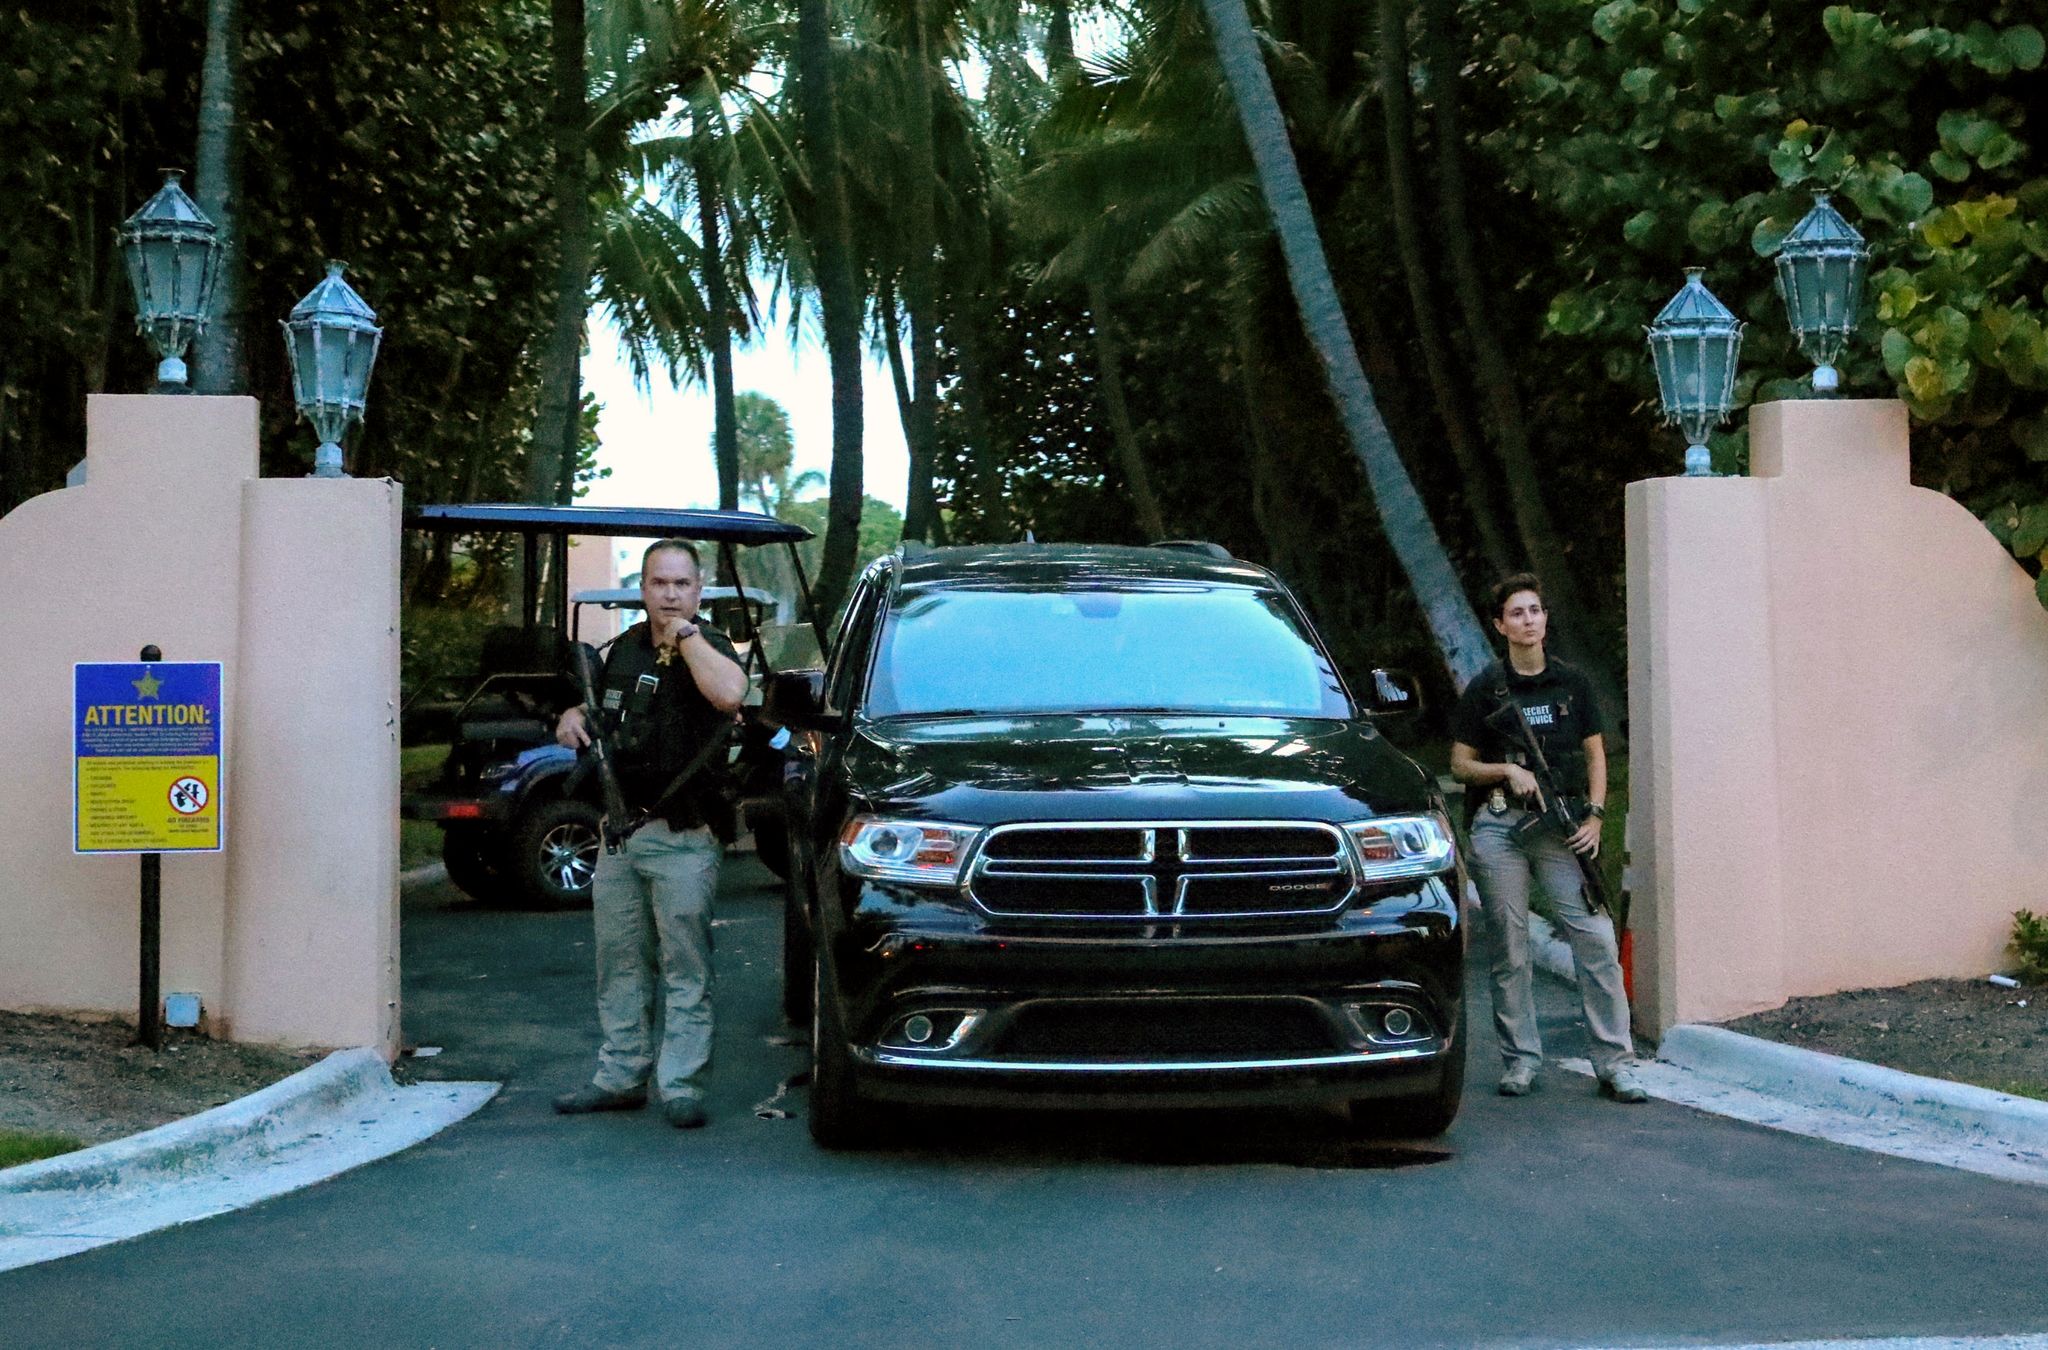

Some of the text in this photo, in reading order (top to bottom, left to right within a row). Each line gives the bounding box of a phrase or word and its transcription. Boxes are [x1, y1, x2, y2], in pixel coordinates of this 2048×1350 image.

[84, 704, 211, 725] ATTENTION:
[1522, 705, 1550, 716] SECRET
[1526, 714, 1554, 725] ERVICE
[1269, 883, 1329, 891] DODGE
